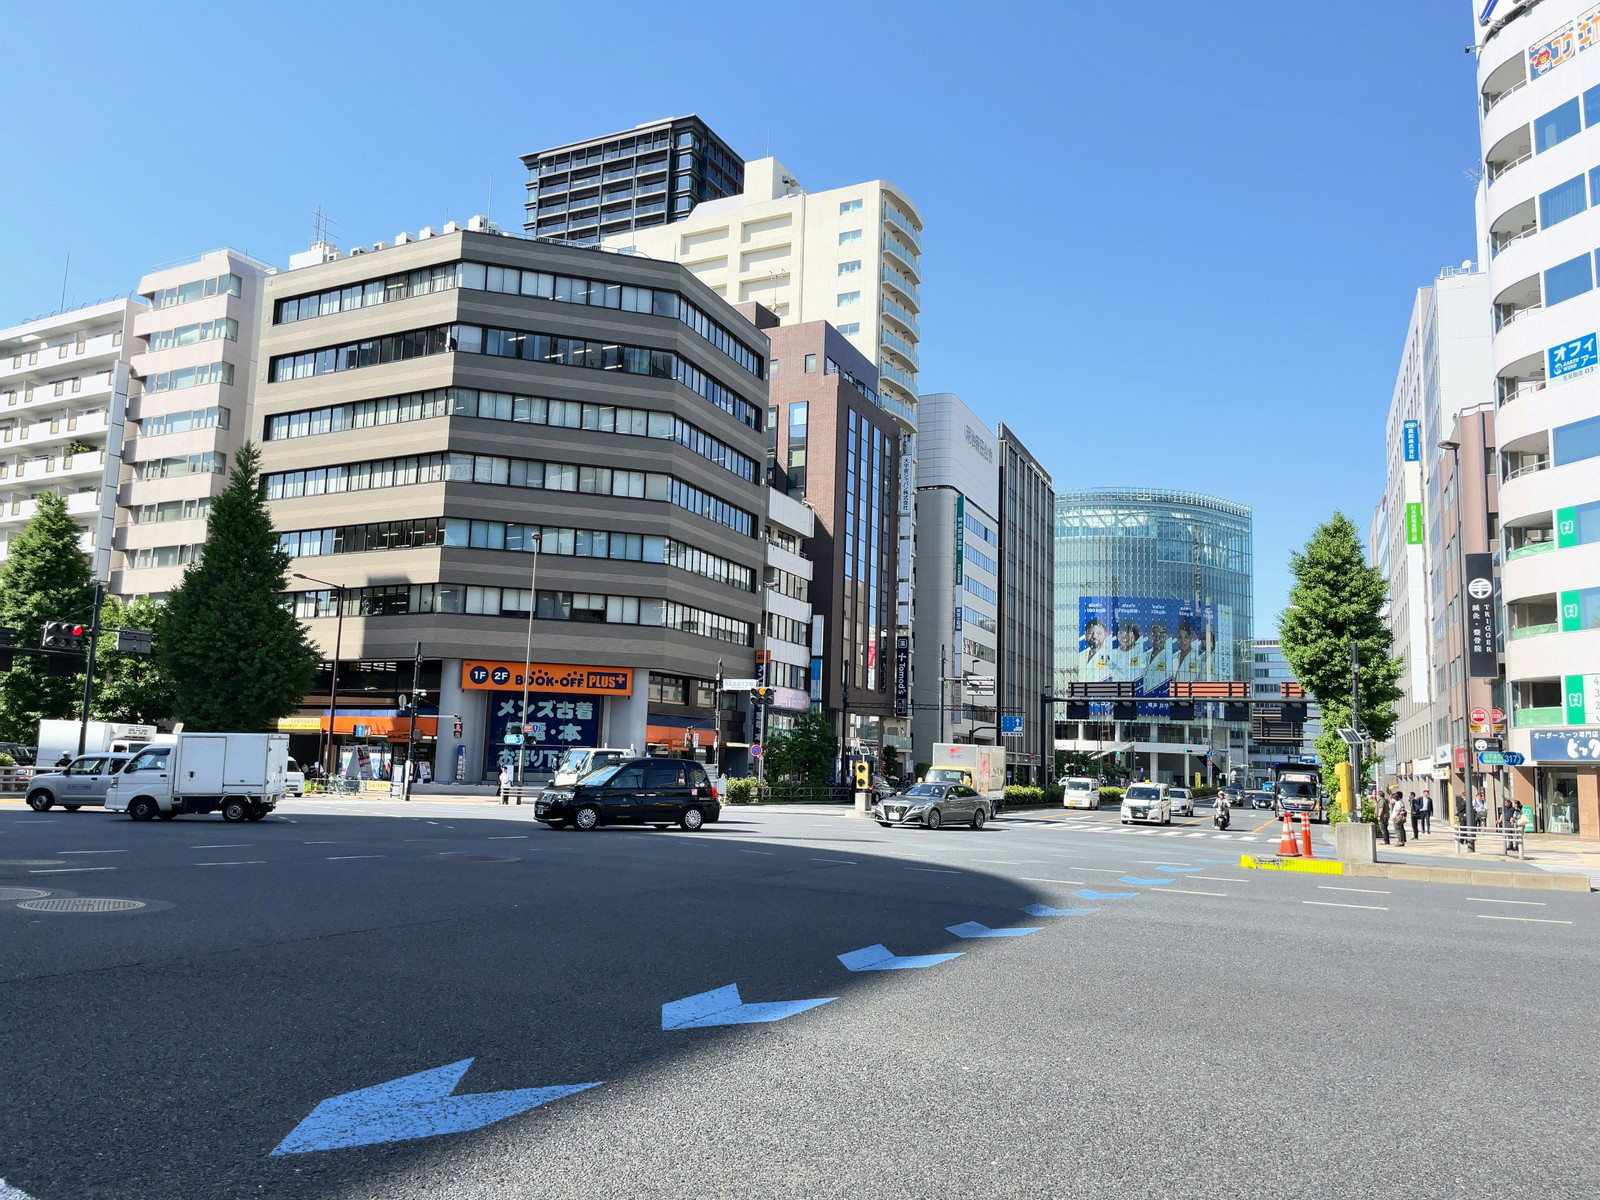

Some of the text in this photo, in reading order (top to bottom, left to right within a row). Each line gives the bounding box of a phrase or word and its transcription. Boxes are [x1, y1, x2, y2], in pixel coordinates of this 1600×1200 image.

[1554, 338, 1594, 362] オフィ
[1484, 604, 1492, 652] TRIGGER
[474, 671, 486, 679] 1F
[494, 672, 508, 680] 2F
[898, 663, 907, 695] Tomod's
[498, 700, 594, 720] メンズ古着
[1533, 731, 1599, 739] オーダースーツ専門店
[1504, 755, 1518, 763] 317
